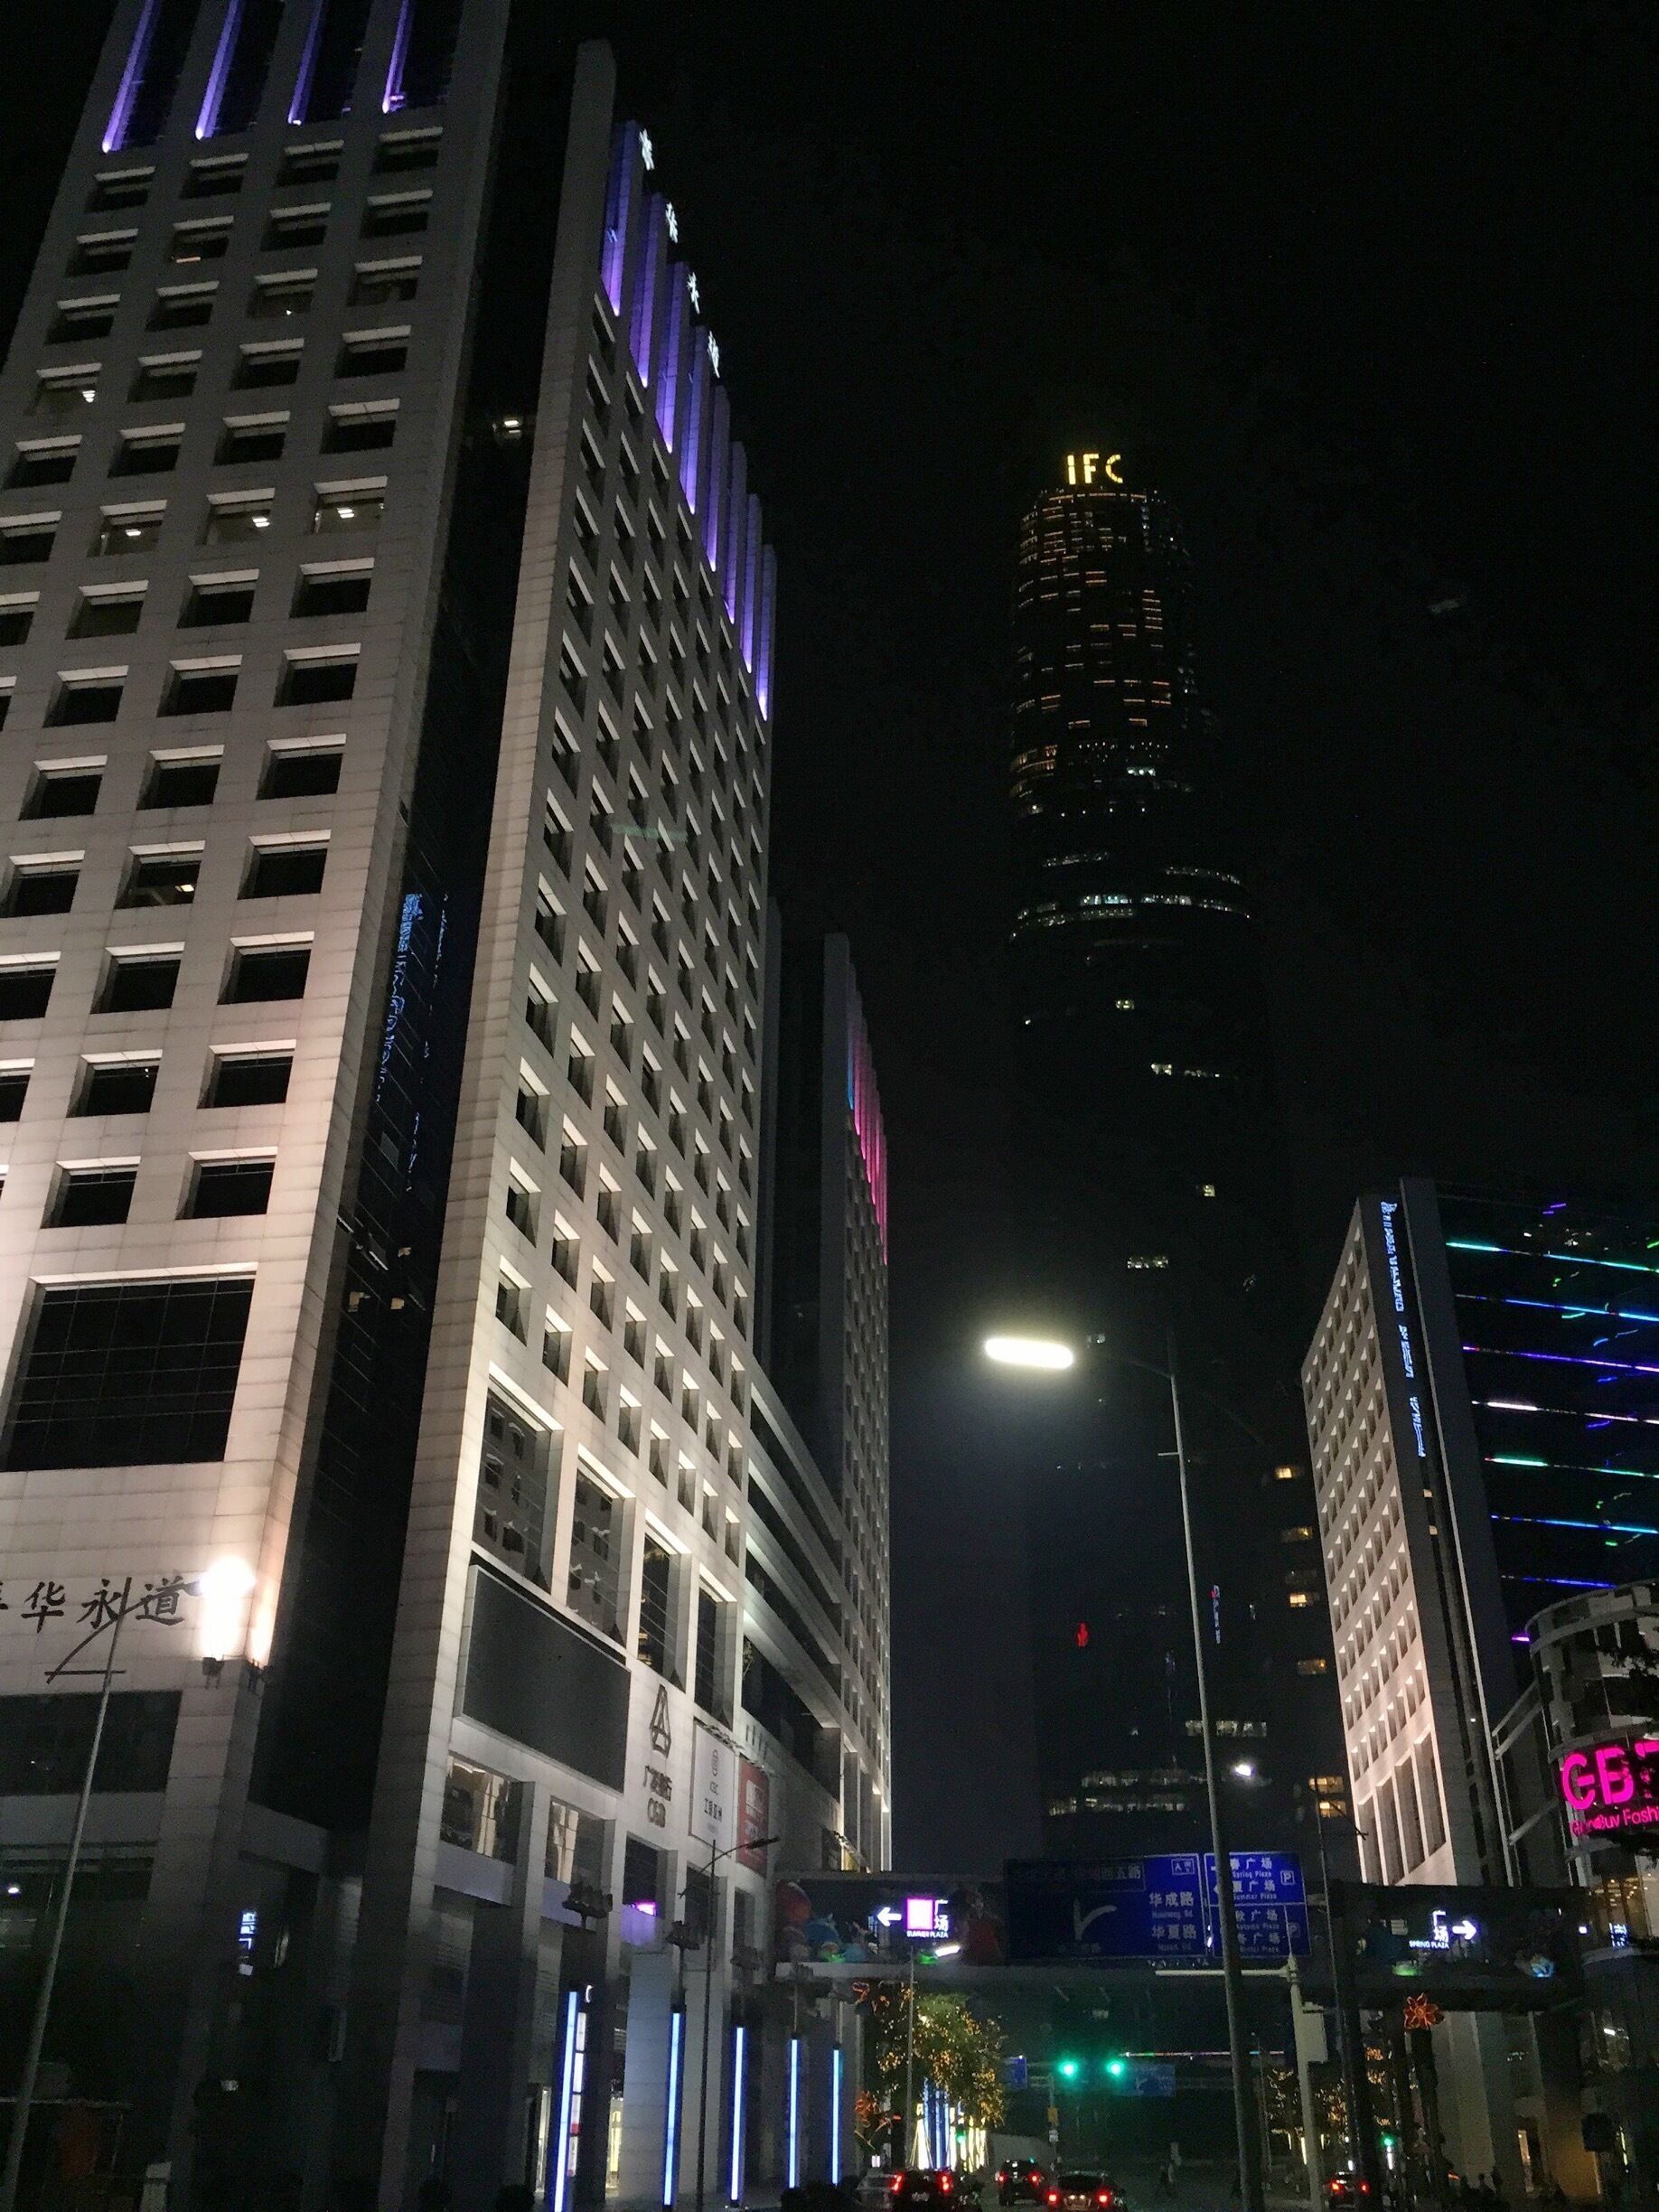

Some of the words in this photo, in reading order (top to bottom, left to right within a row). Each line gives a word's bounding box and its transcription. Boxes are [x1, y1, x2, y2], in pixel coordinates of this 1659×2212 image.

[1067, 453, 1123, 485] IFC
[1562, 1740, 1659, 1810] GB
[1623, 1805, 1659, 1826] Fash
